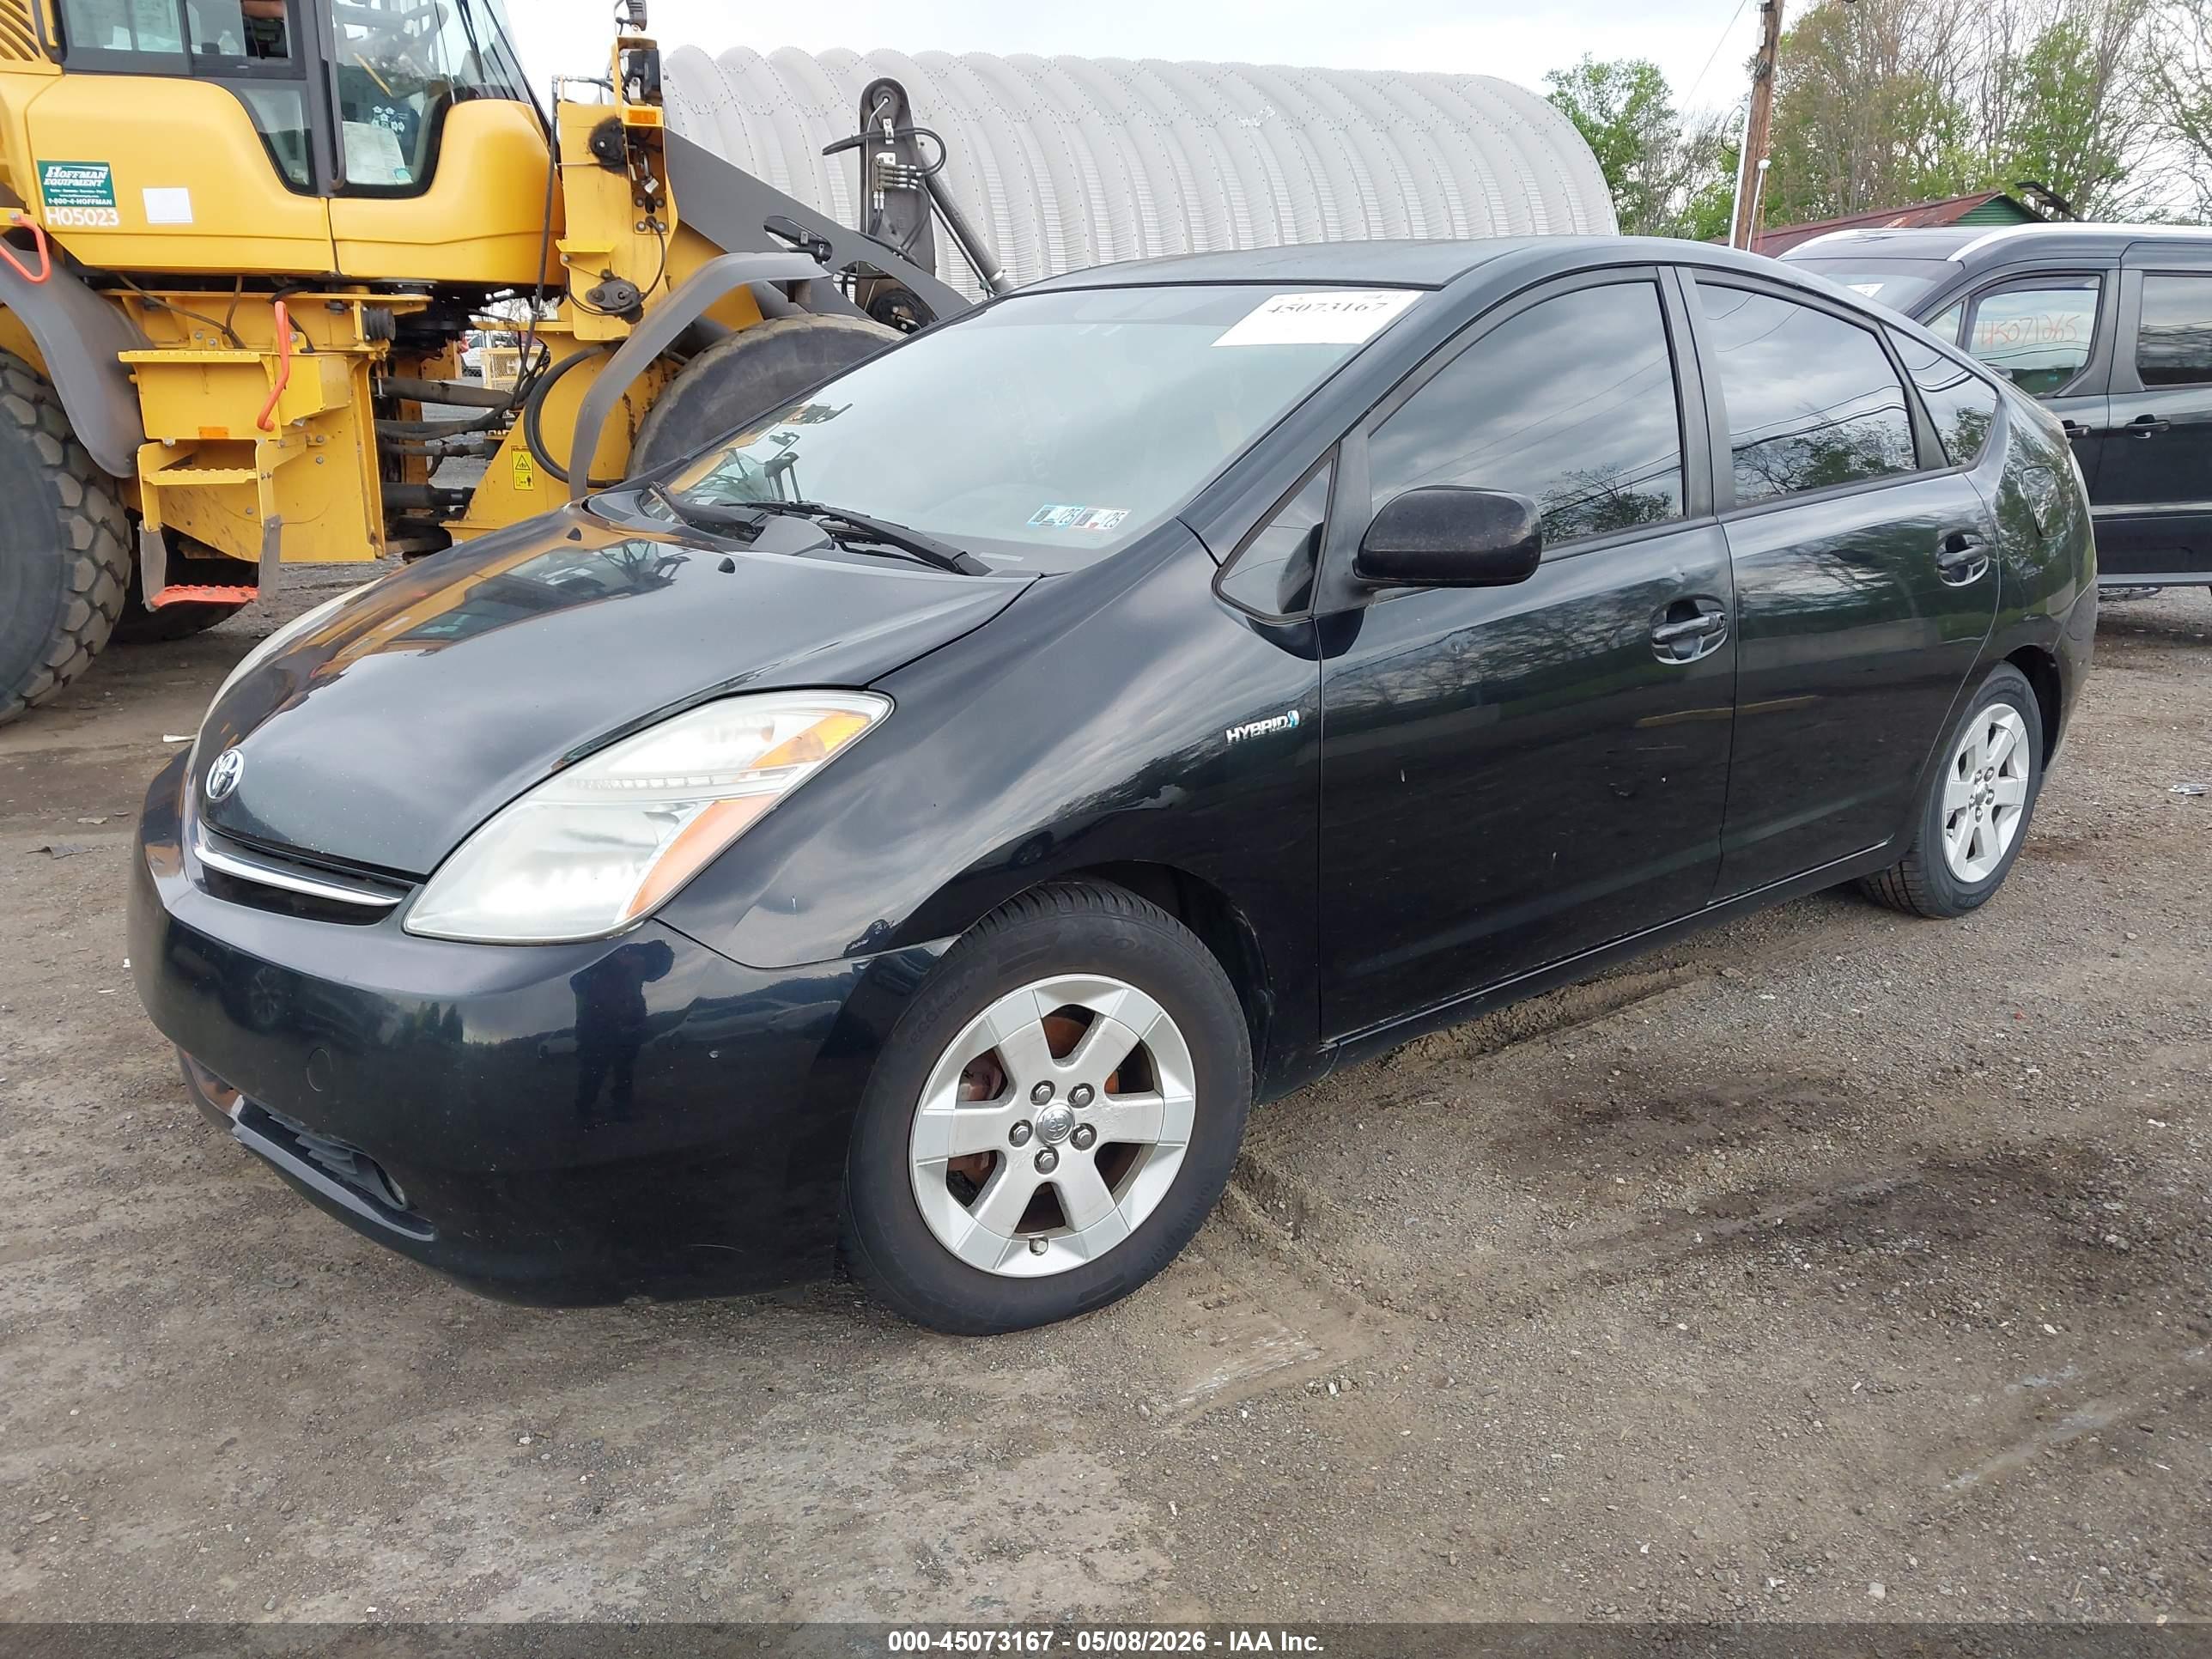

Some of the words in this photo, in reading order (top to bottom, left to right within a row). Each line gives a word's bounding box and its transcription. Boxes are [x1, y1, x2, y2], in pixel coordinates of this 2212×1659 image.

[46, 166, 108, 179] HOFFMAN
[44, 178, 104, 187] EQUIPMENT
[46, 207, 119, 227] H05023
[1266, 301, 1389, 313] 45073167
[1225, 715, 1289, 744] HYBRID
